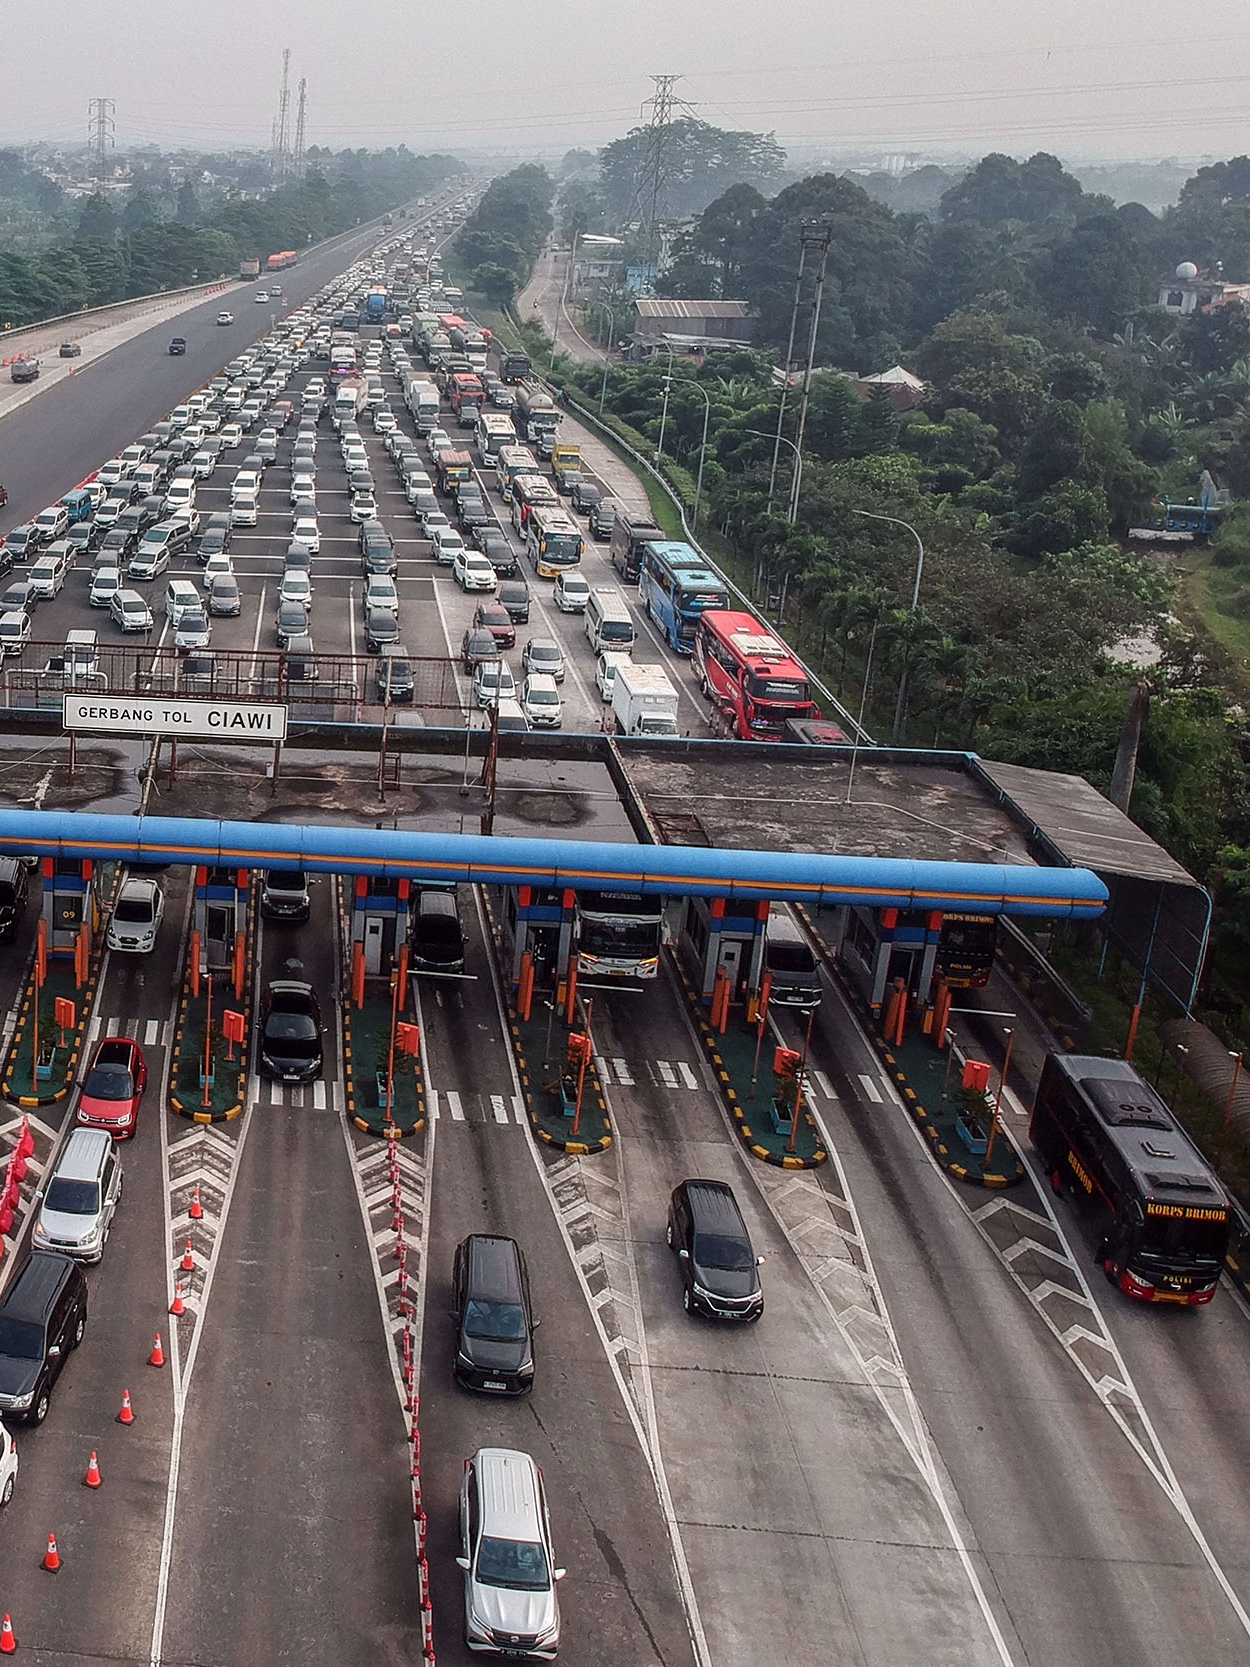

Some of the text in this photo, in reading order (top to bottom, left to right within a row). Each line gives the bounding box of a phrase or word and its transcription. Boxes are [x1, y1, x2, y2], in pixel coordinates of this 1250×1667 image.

[78, 706, 271, 729] GERBANG TOL CIAWI
[62, 910, 75, 919] 09
[1068, 1150, 1092, 1194] BRIMOB
[1147, 1203, 1227, 1221] KORPS BRIMOB
[1162, 1275, 1192, 1284] POLISI
